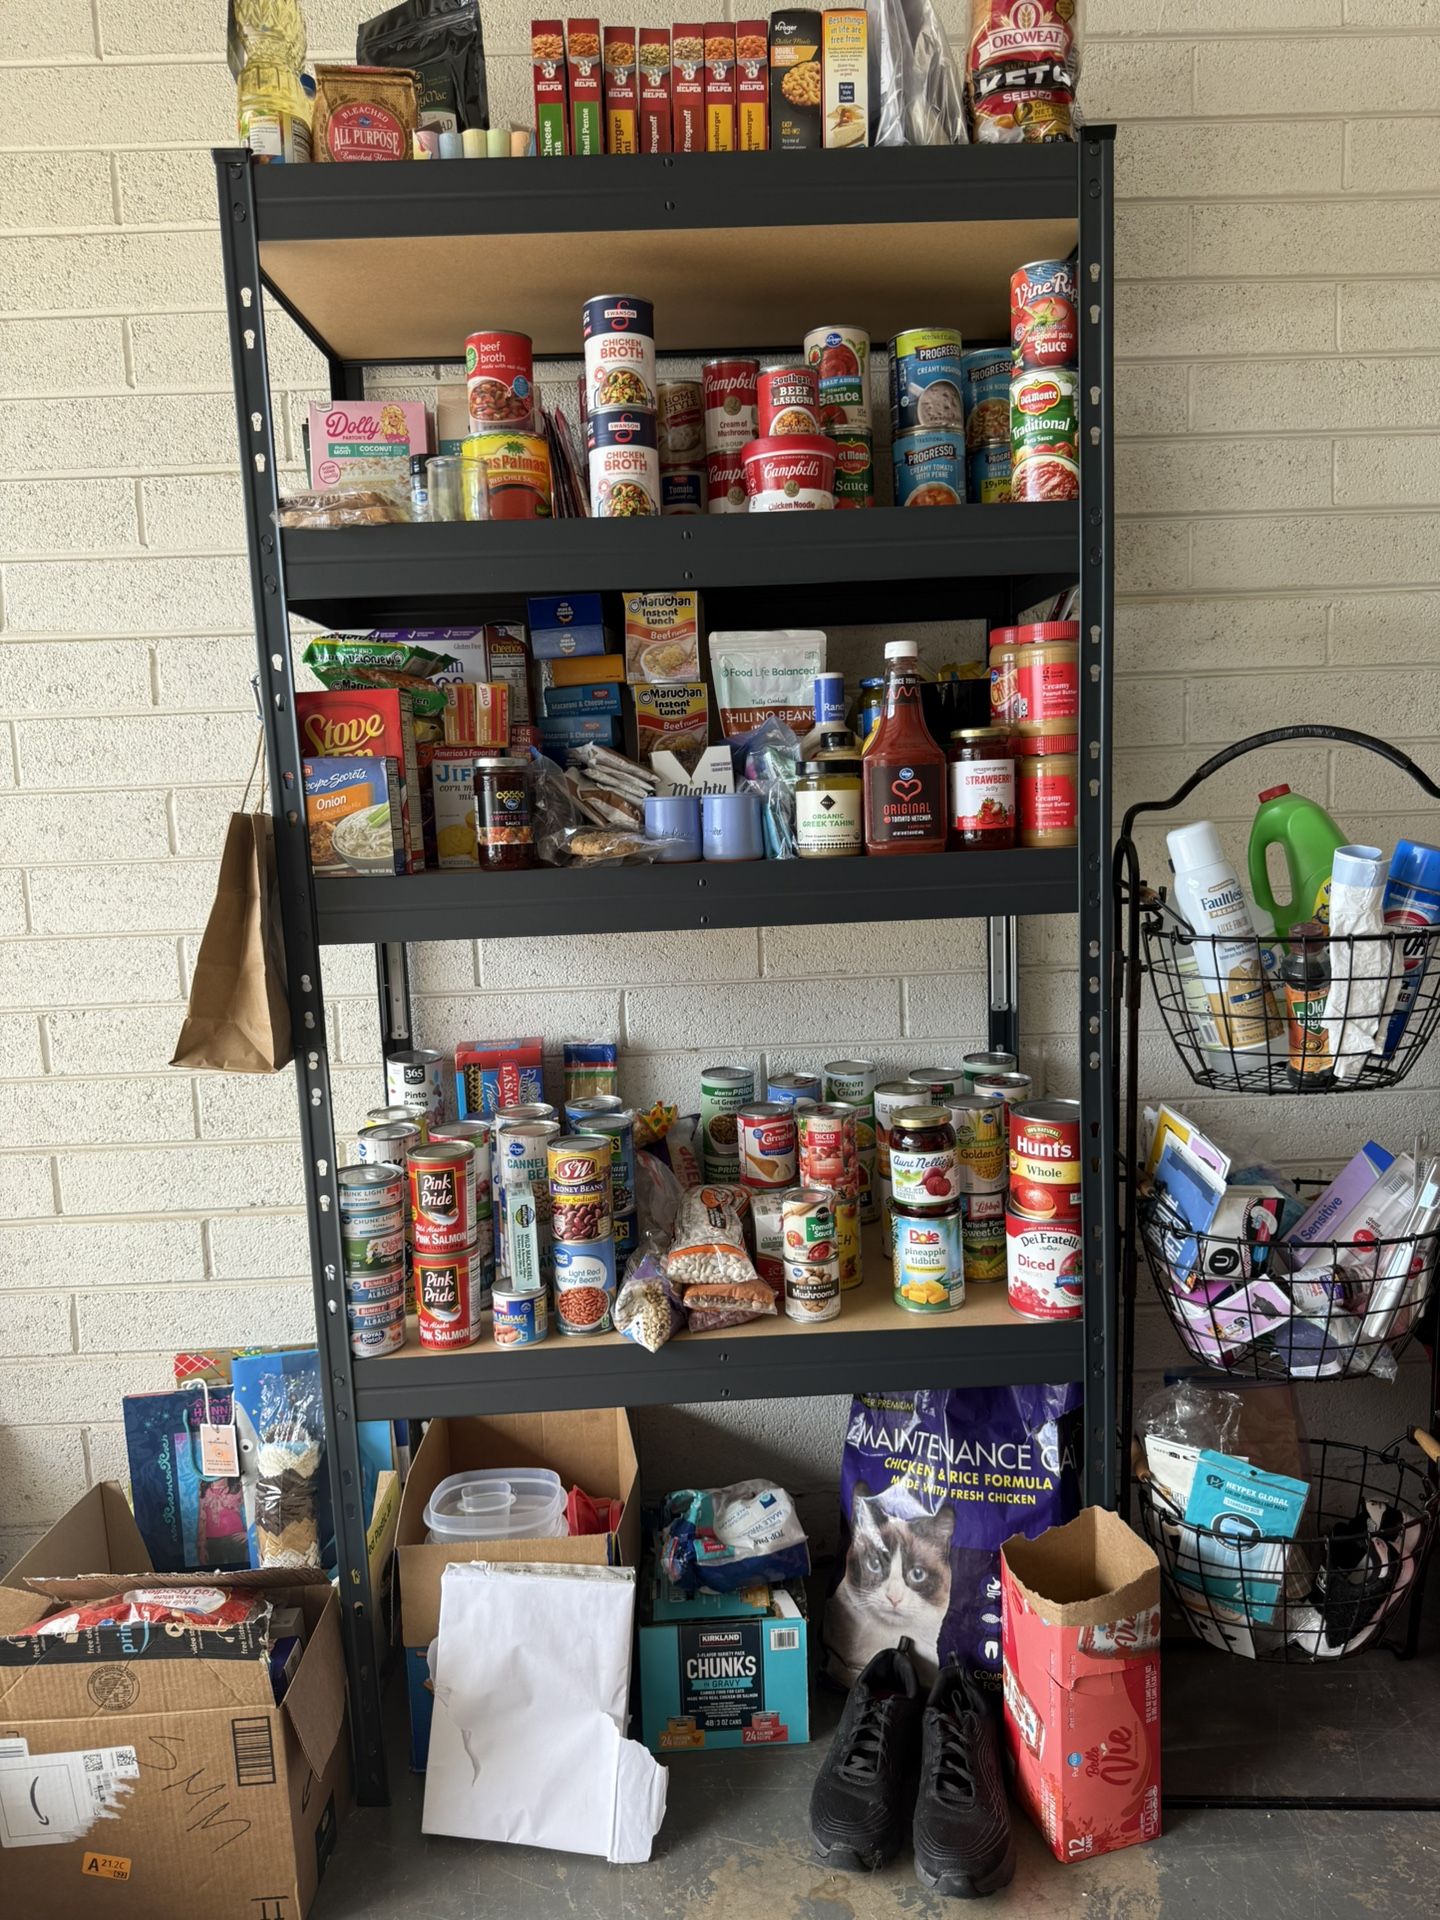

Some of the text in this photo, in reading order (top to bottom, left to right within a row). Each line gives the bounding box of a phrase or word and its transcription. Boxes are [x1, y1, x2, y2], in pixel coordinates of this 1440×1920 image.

[844, 17, 864, 25] things
[775, 21, 797, 34] Kroger
[992, 31, 1061, 48] OROWEAT
[1002, 90, 1051, 103] SEEDED
[341, 107, 389, 124] BLEACHED
[650, 115, 659, 153] Stroganoff
[684, 110, 693, 147] Stroganoff
[334, 128, 351, 152] ALL
[354, 128, 400, 155] PURPOSE
[1015, 282, 1053, 309] Vine
[1059, 331, 1072, 340] pasta
[480, 342, 501, 351] beef
[602, 338, 641, 346] CHICKEN
[1034, 340, 1067, 355] Sauce
[481, 353, 506, 362] broth
[600, 347, 644, 359] BROTH
[917, 366, 940, 375] CREAMY
[780, 387, 809, 396] BEEF
[1020, 390, 1057, 404] Del Monte
[665, 390, 696, 407] HOME
[773, 396, 814, 405] LASAGNA
[819, 392, 860, 405] Sauce
[665, 398, 698, 415] STYLE
[326, 412, 380, 440] Dolly
[1012, 417, 1070, 440] Traditional
[606, 451, 645, 459] CHICKEN
[908, 445, 954, 465] PROGRESSO
[502, 455, 546, 471] Palmas
[604, 459, 647, 471] BROTH
[763, 461, 819, 479] Campbell's
[910, 465, 932, 475] CREAMY
[836, 480, 868, 492] Sauce
[639, 596, 691, 608] Maruchan
[642, 609, 679, 618] Instant
[646, 616, 675, 625] Lunch
[650, 631, 671, 640] Beef
[730, 666, 816, 678] Food Life Balanced
[1042, 682, 1070, 690] Creamy
[650, 688, 702, 699] Maruchan
[655, 700, 690, 708] Instant
[659, 708, 688, 716] Lunch
[663, 721, 683, 730] Beef
[304, 714, 385, 756] Stove
[512, 728, 531, 736] RICE
[330, 768, 367, 788] Secrets
[439, 785, 462, 793] corn
[316, 795, 347, 810] Onion
[1035, 794, 1062, 802] Creamy
[883, 803, 931, 815] ORIGINAL
[1307, 1000, 1324, 1015] Old
[404, 1069, 424, 1079] 365
[833, 1081, 864, 1089] Green
[837, 1089, 864, 1097] Giant
[721, 1098, 741, 1106] Green
[893, 1155, 914, 1166] Aunt
[961, 1149, 995, 1160] Golden
[1026, 1164, 1062, 1178] Whole
[423, 1174, 451, 1190] Pink
[364, 1189, 386, 1197] LIGHT
[553, 1184, 603, 1193] KIDNEY BEANS
[421, 1190, 452, 1206] Pride
[1301, 1196, 1343, 1240] Sensitive
[432, 1232, 466, 1244] SALMON
[814, 1230, 832, 1238] Sauce
[909, 1230, 940, 1242] Dole
[962, 1228, 991, 1238] Sweet
[1021, 1233, 1079, 1249] Dei Fratelli
[905, 1248, 946, 1257] pineapple
[911, 1257, 940, 1266] tidbits
[1017, 1254, 1055, 1271] Diced
[568, 1268, 601, 1277] Light Red
[425, 1271, 454, 1287] Pink
[558, 1275, 601, 1285] Kidney Beans
[368, 1286, 399, 1299] ALBACORE
[425, 1289, 455, 1303] Pride
[792, 1288, 835, 1299] Mushrooms
[364, 1314, 397, 1326] ALBACORE
[435, 1327, 470, 1341] SALMON
[878, 1399, 914, 1411] PREMIUM
[858, 1421, 1031, 1470] MAINTENANCE
[884, 1457, 1053, 1490] CHICKEN & RICE FORMULA
[891, 1475, 1036, 1505] MADE WITH FRESH CHICKEN
[1226, 1482, 1256, 1497] HEYPEX
[1258, 1492, 1289, 1507] GLOBAL
[687, 1656, 756, 1679] CHUNKS
[712, 1680, 740, 1688] GRAVY
[746, 1731, 756, 1741] 24
[1085, 1745, 1101, 1778] Belle
[1100, 1725, 1140, 1786] Vie
[1068, 1836, 1086, 1858] 12
[1085, 1833, 1094, 1853] CANS
[87, 1857, 125, 1872] A 21.2C
